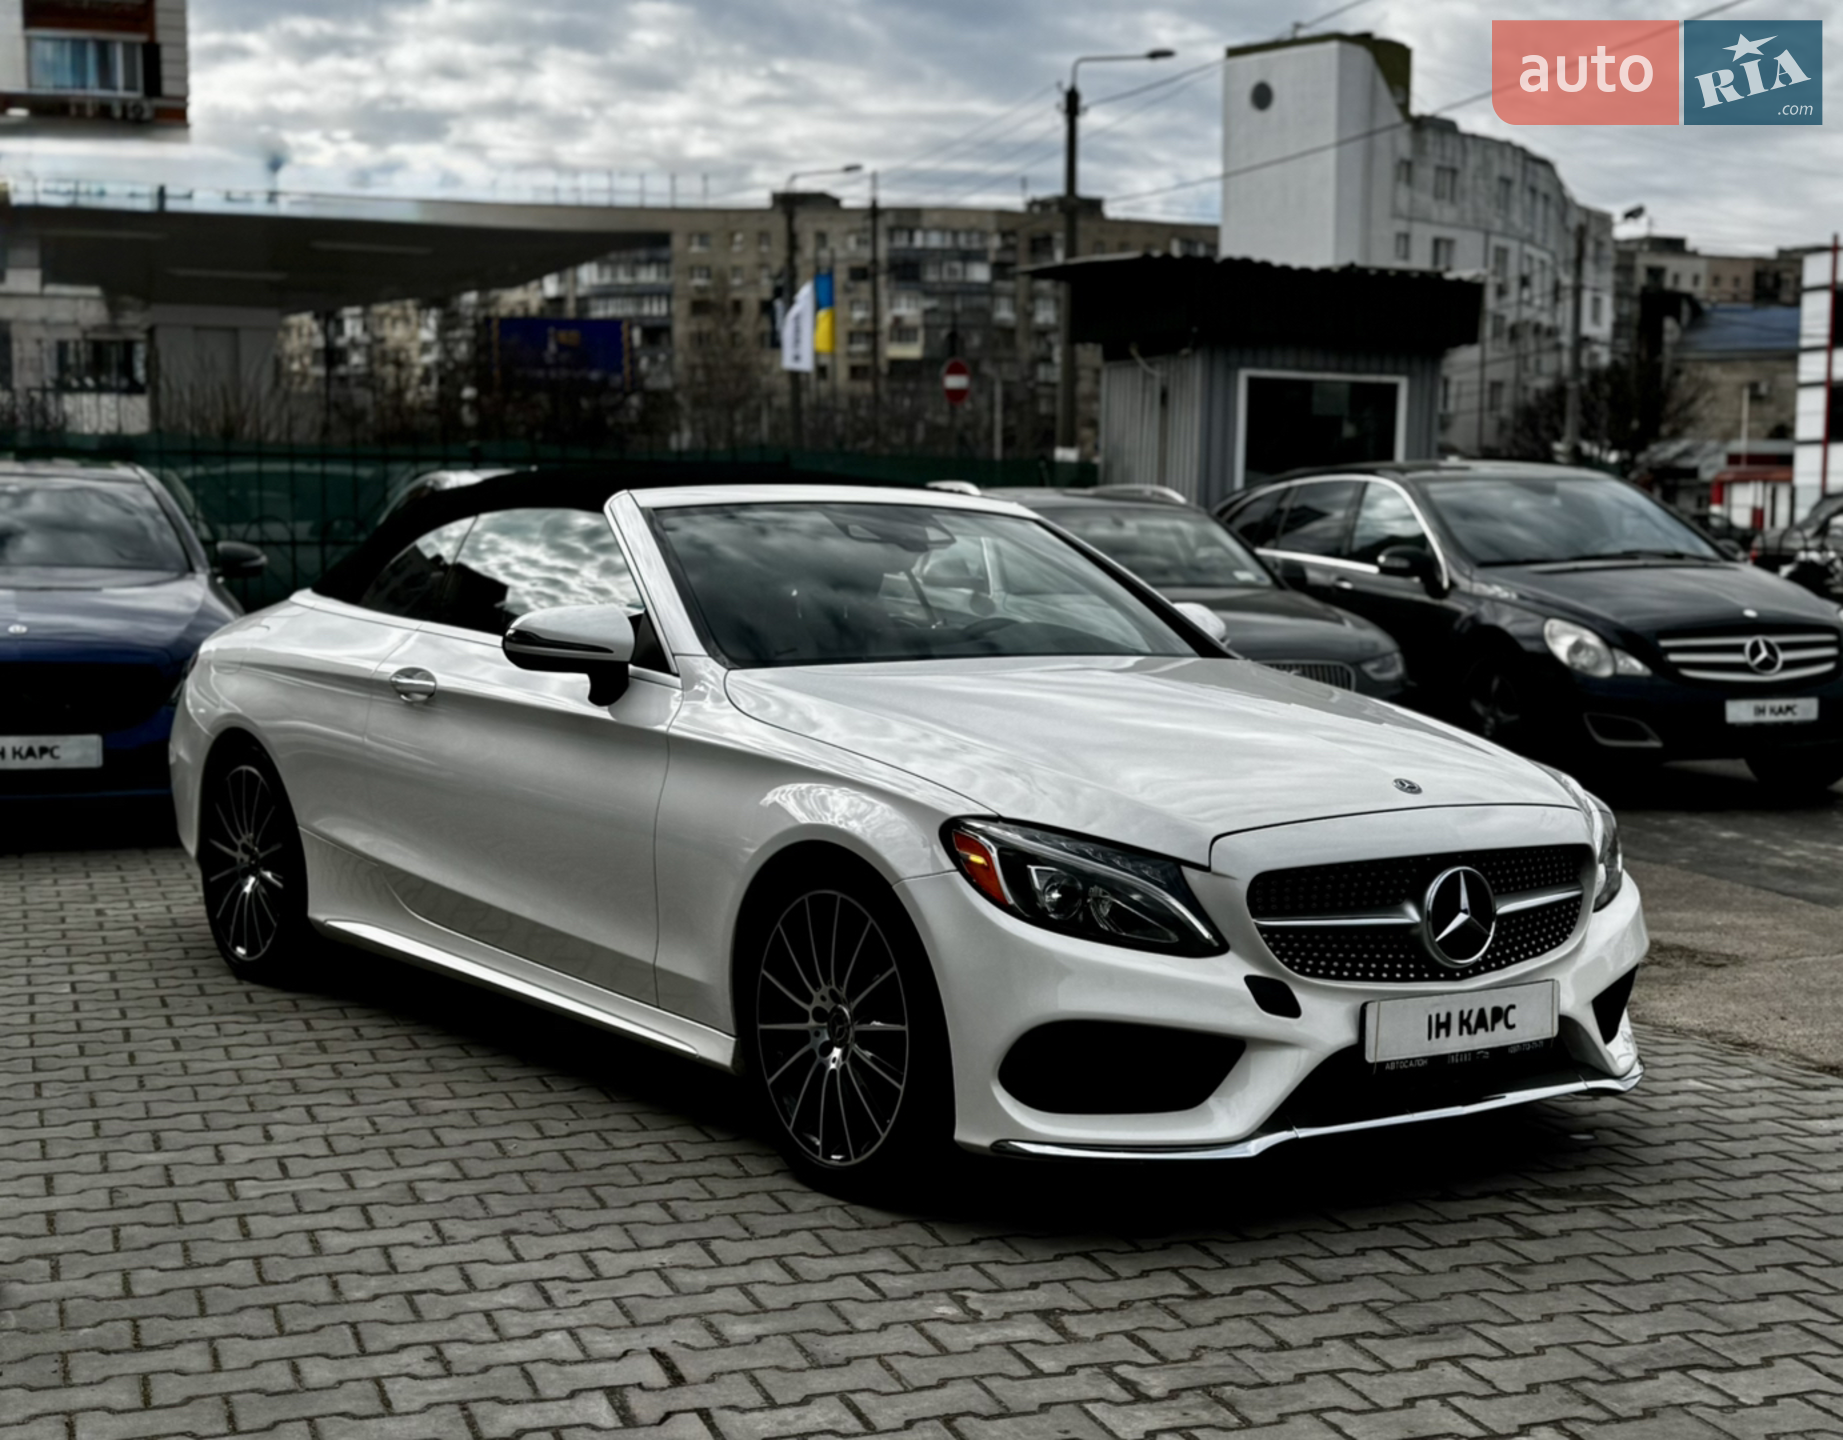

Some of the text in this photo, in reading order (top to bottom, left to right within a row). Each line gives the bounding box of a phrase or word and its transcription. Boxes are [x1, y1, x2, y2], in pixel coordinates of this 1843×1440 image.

[11, 745, 61, 760] КАРС
[1459, 1004, 1516, 1036] КАРС
[1385, 1059, 1428, 1071] АВТОСАЛОН
